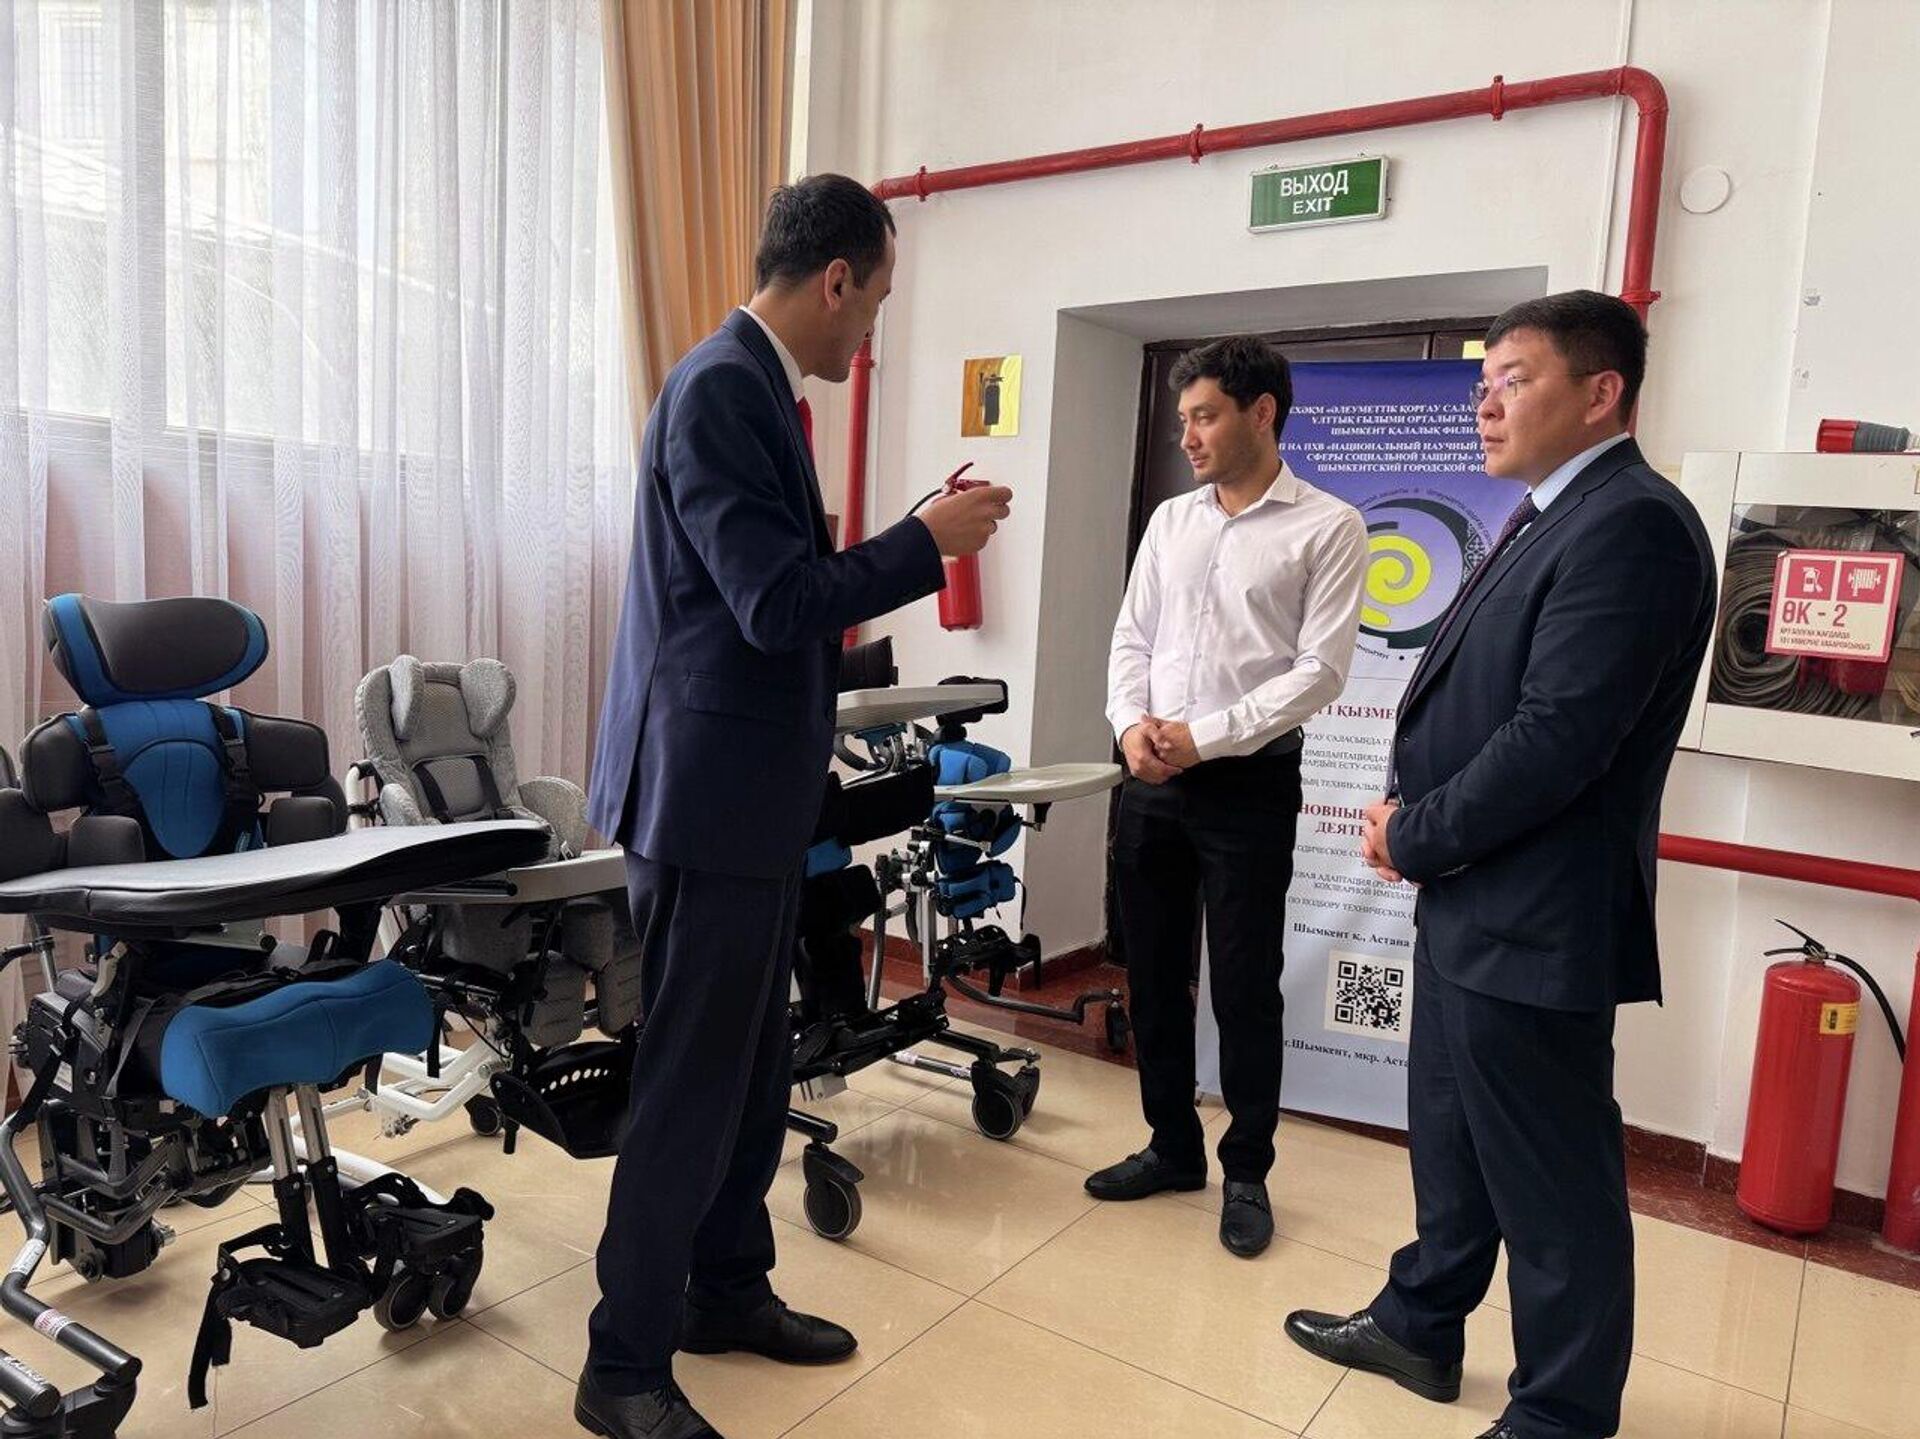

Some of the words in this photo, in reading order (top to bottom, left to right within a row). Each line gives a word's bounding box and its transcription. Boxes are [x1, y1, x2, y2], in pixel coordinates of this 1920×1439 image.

[1280, 170, 1349, 197] ВЫХОД
[1292, 197, 1334, 214] EXIT
[1356, 415, 1405, 424] ҒЫЛЫМИ
[1331, 427, 1387, 435] ШЫМКЕНТ
[1287, 442, 1302, 450] НА
[1303, 442, 1325, 451] ПХВ
[1326, 441, 1421, 452] «НАЦИОНАЛЬНЫЙ
[1423, 441, 1477, 450] НАУЧНЫЙ
[1306, 453, 1343, 461] СФЕРЫ
[1344, 451, 1418, 462] СОЦИАЛЬНОЙ
[1420, 453, 1474, 462] ЗАЩИТЫ»
[1317, 462, 1401, 472] ШЫМКЕНТСКИЙ
[1403, 462, 1465, 473] ГОРОДСКОЙ
[1781, 600, 1812, 624] ӨК
[1832, 603, 1848, 627] 2
[1293, 922, 1349, 939] Шымкент
[1368, 934, 1410, 947] Астана
[1353, 1051, 1380, 1064] мкр.
